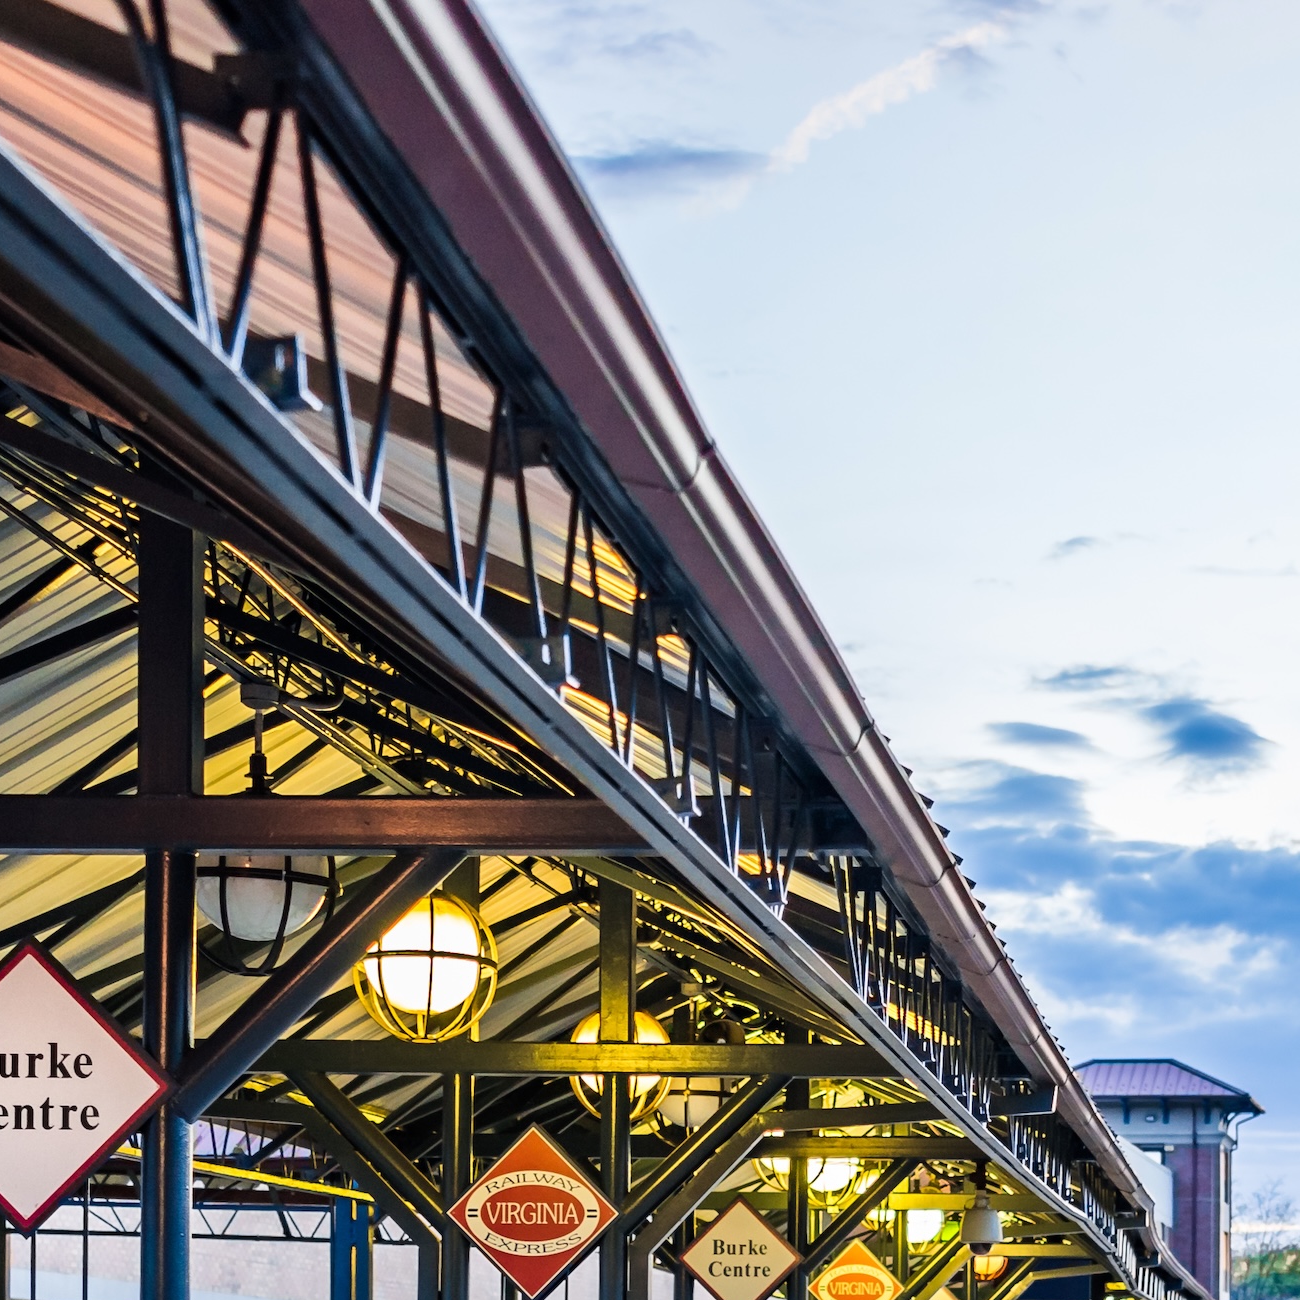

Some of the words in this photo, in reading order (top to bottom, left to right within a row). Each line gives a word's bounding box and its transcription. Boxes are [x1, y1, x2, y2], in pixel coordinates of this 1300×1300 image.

[485, 1172, 581, 1194] RAILWAY
[485, 1202, 580, 1225] VIRGINIA
[484, 1232, 582, 1254] EXPRESS
[712, 1239, 768, 1256] Burke
[708, 1260, 771, 1278] Centre
[829, 1281, 882, 1296] VIRGINIA
